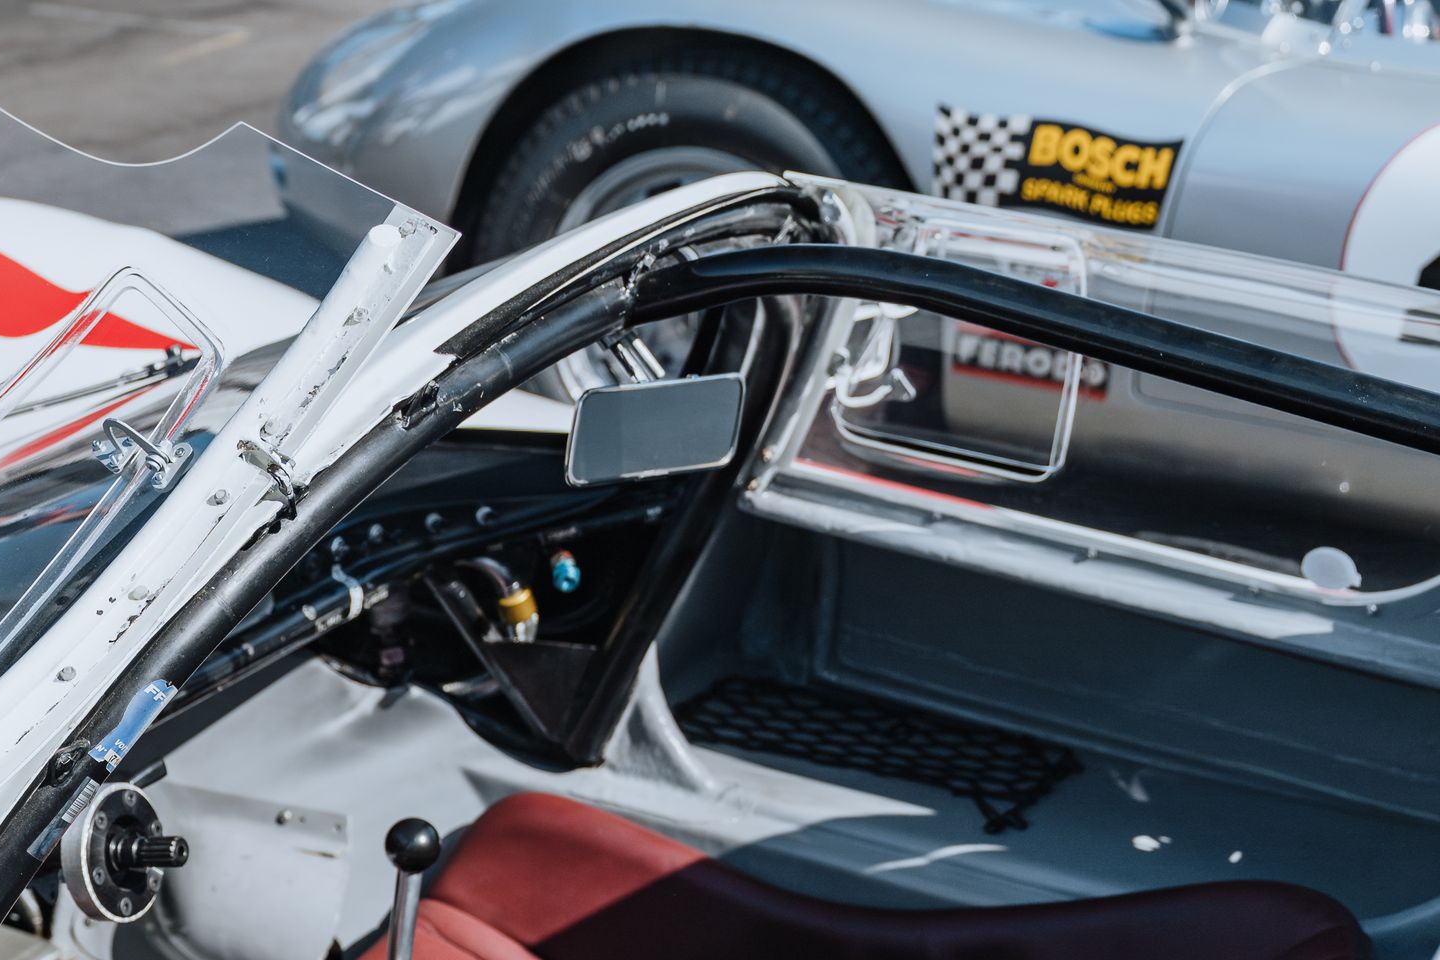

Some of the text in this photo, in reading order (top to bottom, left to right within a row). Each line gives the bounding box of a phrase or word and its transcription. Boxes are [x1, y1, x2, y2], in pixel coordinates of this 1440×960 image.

[1028, 124, 1174, 190] BOSCH
[1021, 177, 1089, 213] SPARK
[1090, 192, 1159, 226] PLUGS
